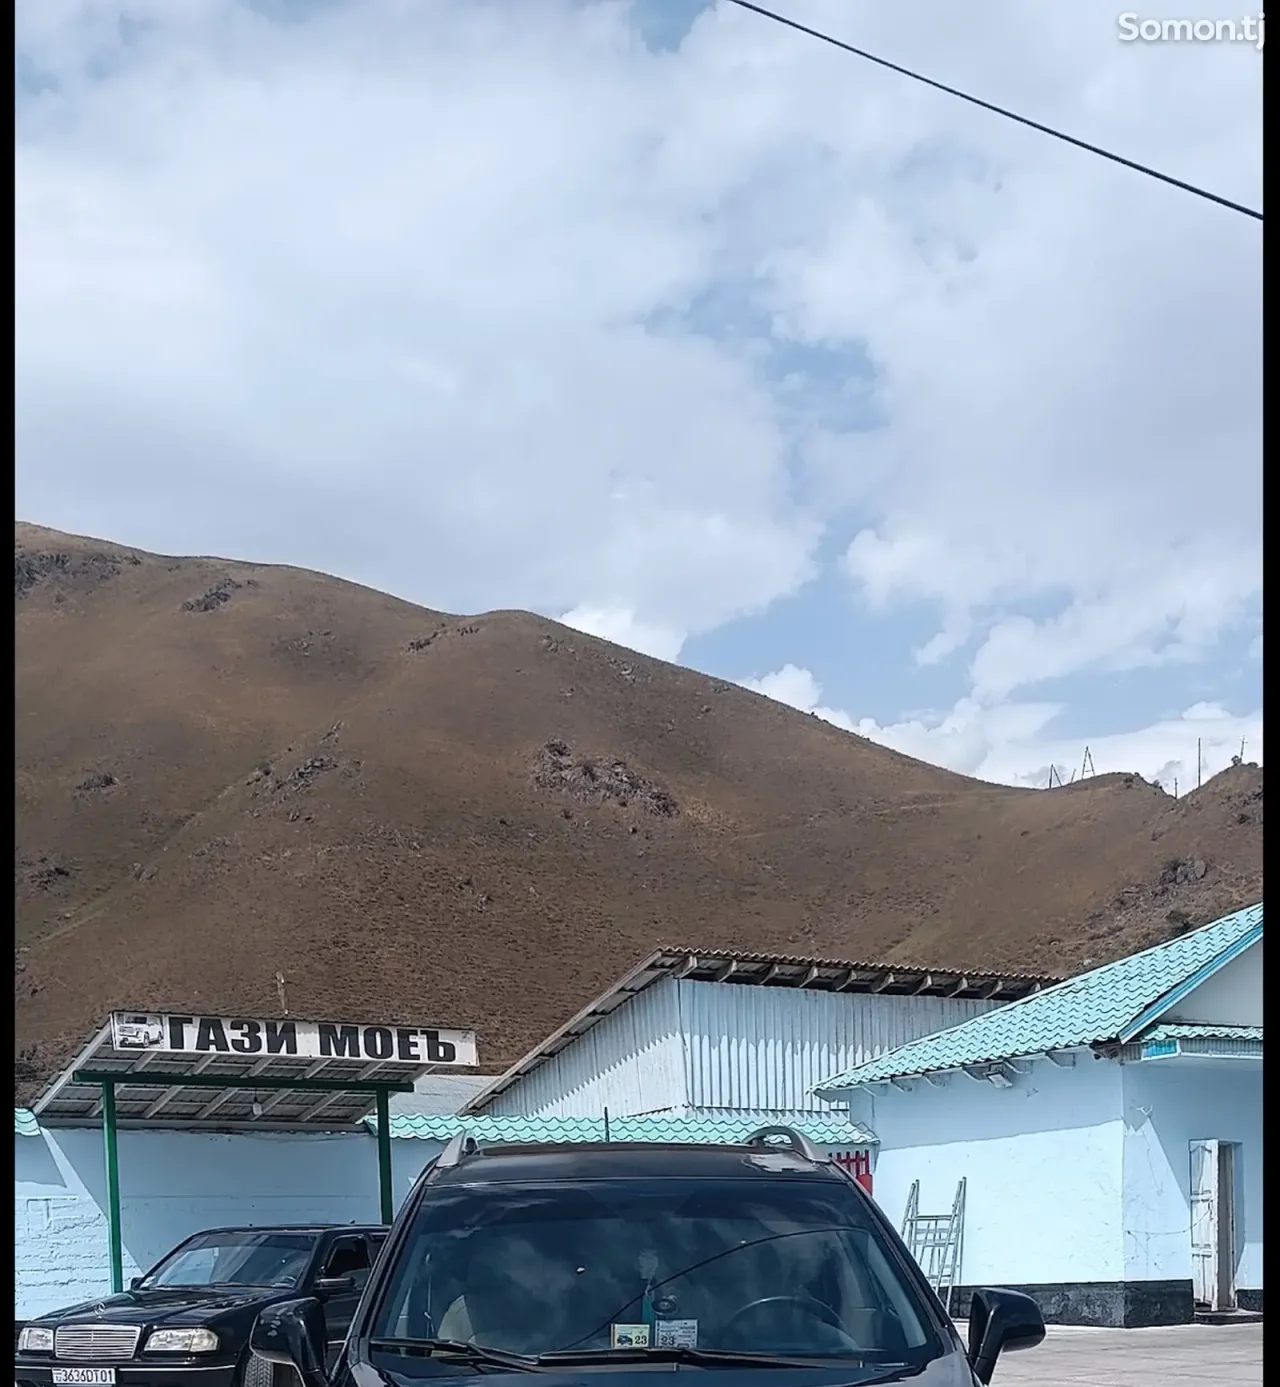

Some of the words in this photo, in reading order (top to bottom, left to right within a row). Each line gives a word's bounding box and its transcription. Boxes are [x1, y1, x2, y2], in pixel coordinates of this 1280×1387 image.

[167, 1016, 299, 1055] ГАЗИ
[318, 1023, 457, 1063] МОЕЪ
[634, 1335, 648, 1345] 23
[62, 1369, 113, 1383] 3636DT01
